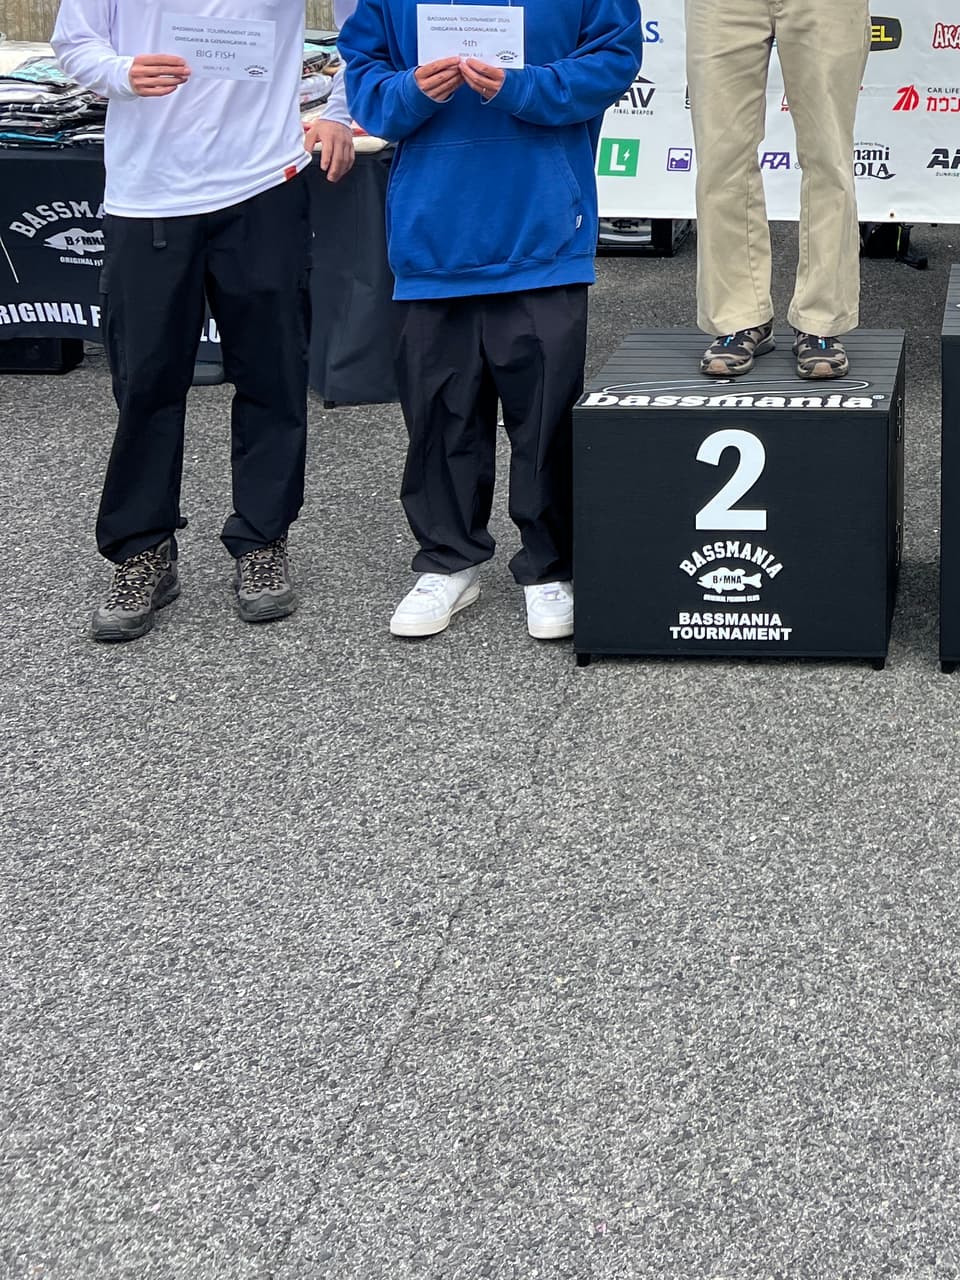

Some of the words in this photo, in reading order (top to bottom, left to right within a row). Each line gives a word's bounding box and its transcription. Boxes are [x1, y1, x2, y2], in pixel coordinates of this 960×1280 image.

[462, 39, 478, 48] 4th
[195, 49, 212, 59] BIG
[214, 50, 236, 59] FISH
[581, 392, 874, 408] bassmania
[695, 428, 767, 531] 2
[679, 540, 784, 579] BASSMANIA
[678, 612, 783, 626] BASSMANIA
[669, 626, 793, 641] TOURNAMENT
